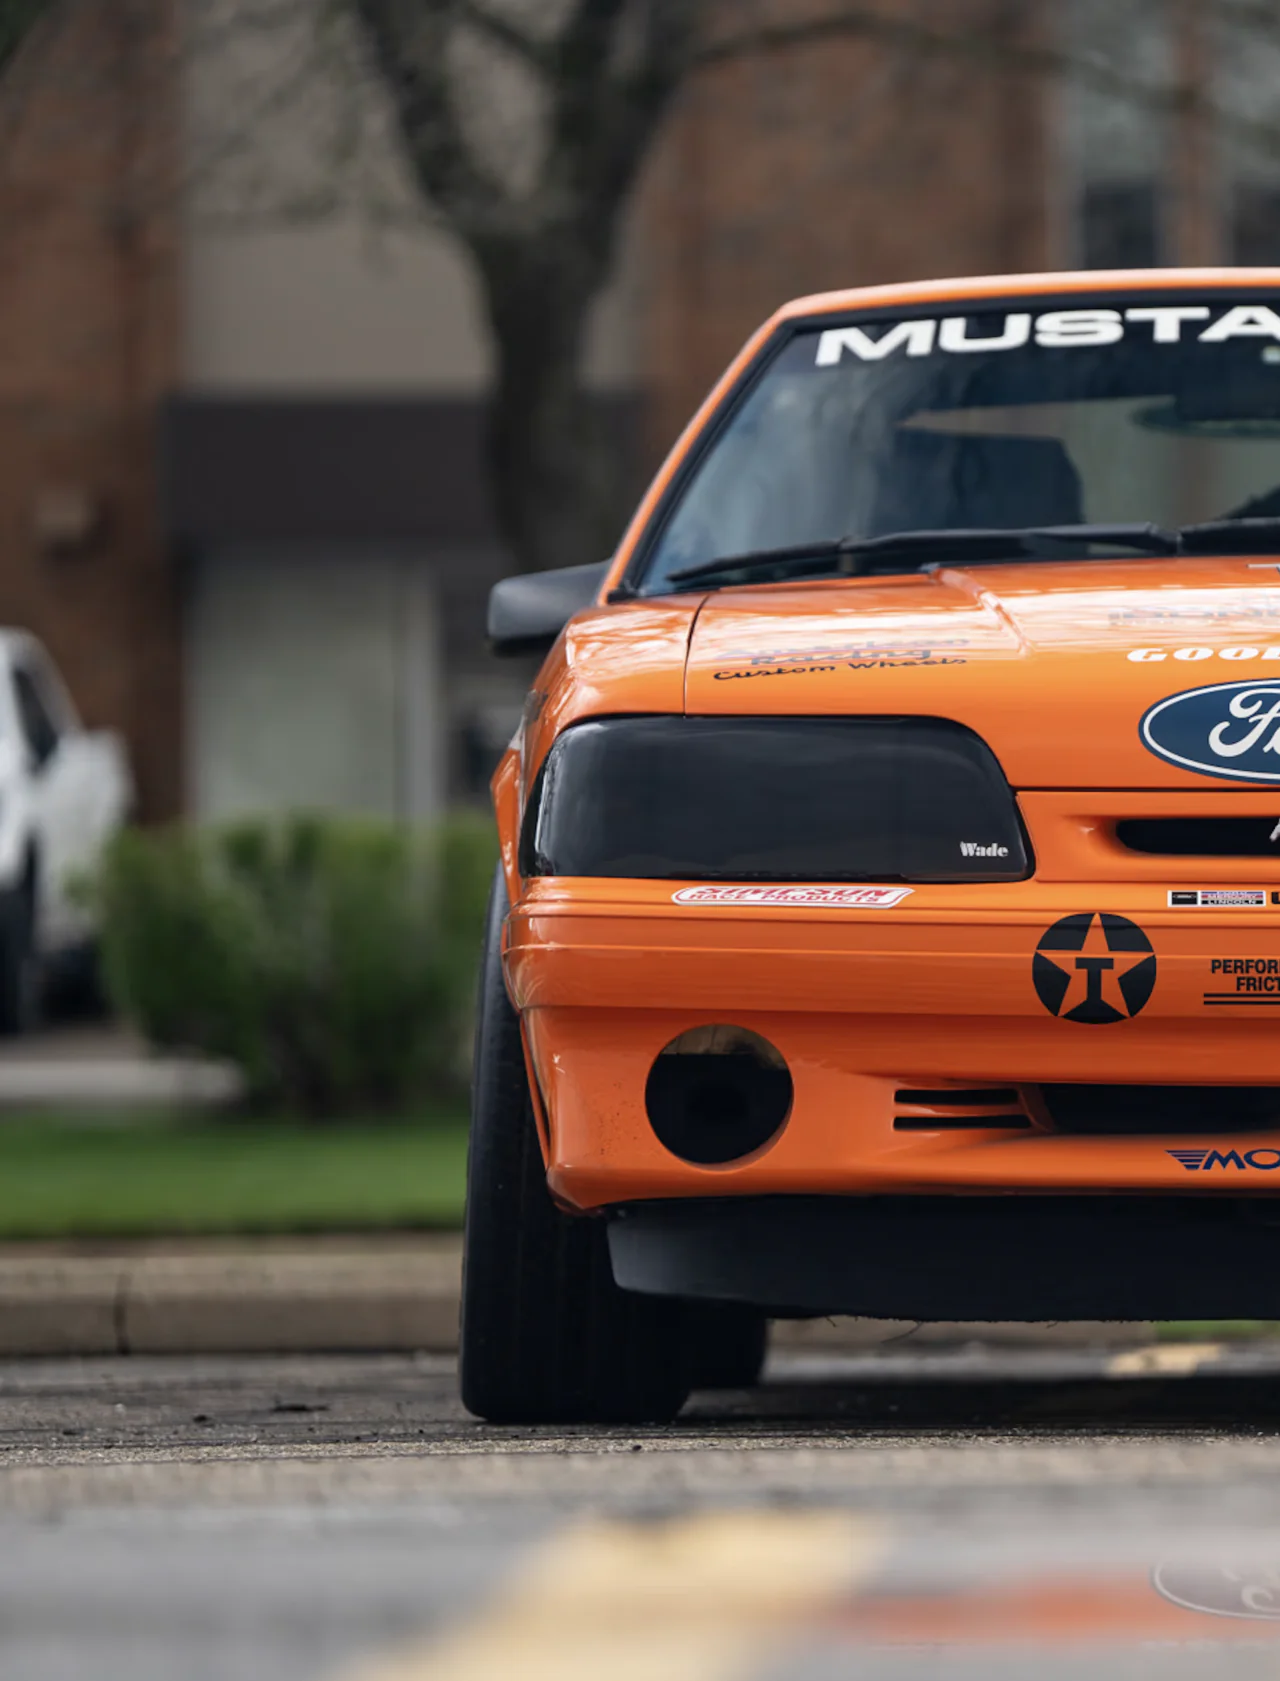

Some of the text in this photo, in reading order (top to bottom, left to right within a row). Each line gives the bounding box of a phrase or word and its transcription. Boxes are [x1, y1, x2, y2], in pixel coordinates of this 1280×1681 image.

[751, 649, 932, 666] Racing
[713, 657, 967, 681] Custom Wheels
[959, 841, 1009, 857] Wade
[1075, 957, 1113, 1003] T
